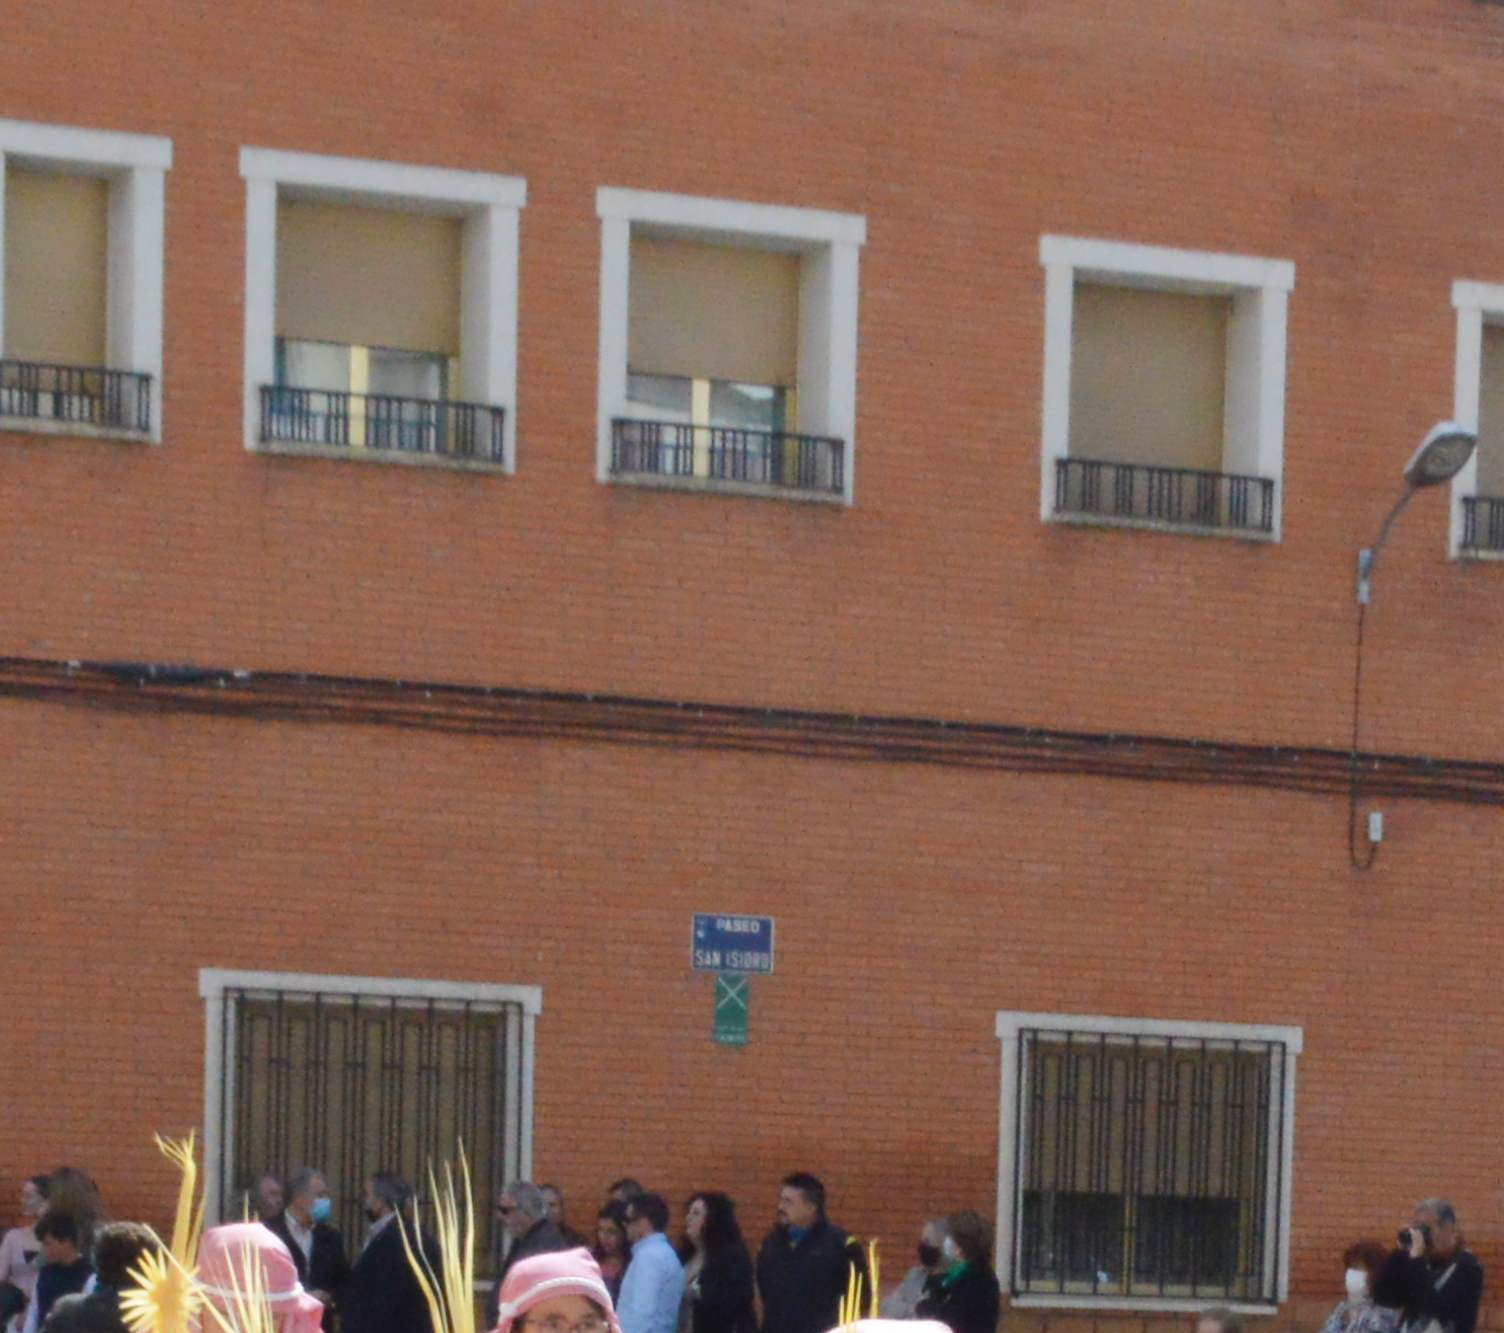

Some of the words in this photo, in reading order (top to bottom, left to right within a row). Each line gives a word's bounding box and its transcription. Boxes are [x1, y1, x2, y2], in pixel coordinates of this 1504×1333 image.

[716, 918, 760, 934] PASEO
[695, 949, 721, 967] SAN
[725, 950, 770, 969] ISIDRO
